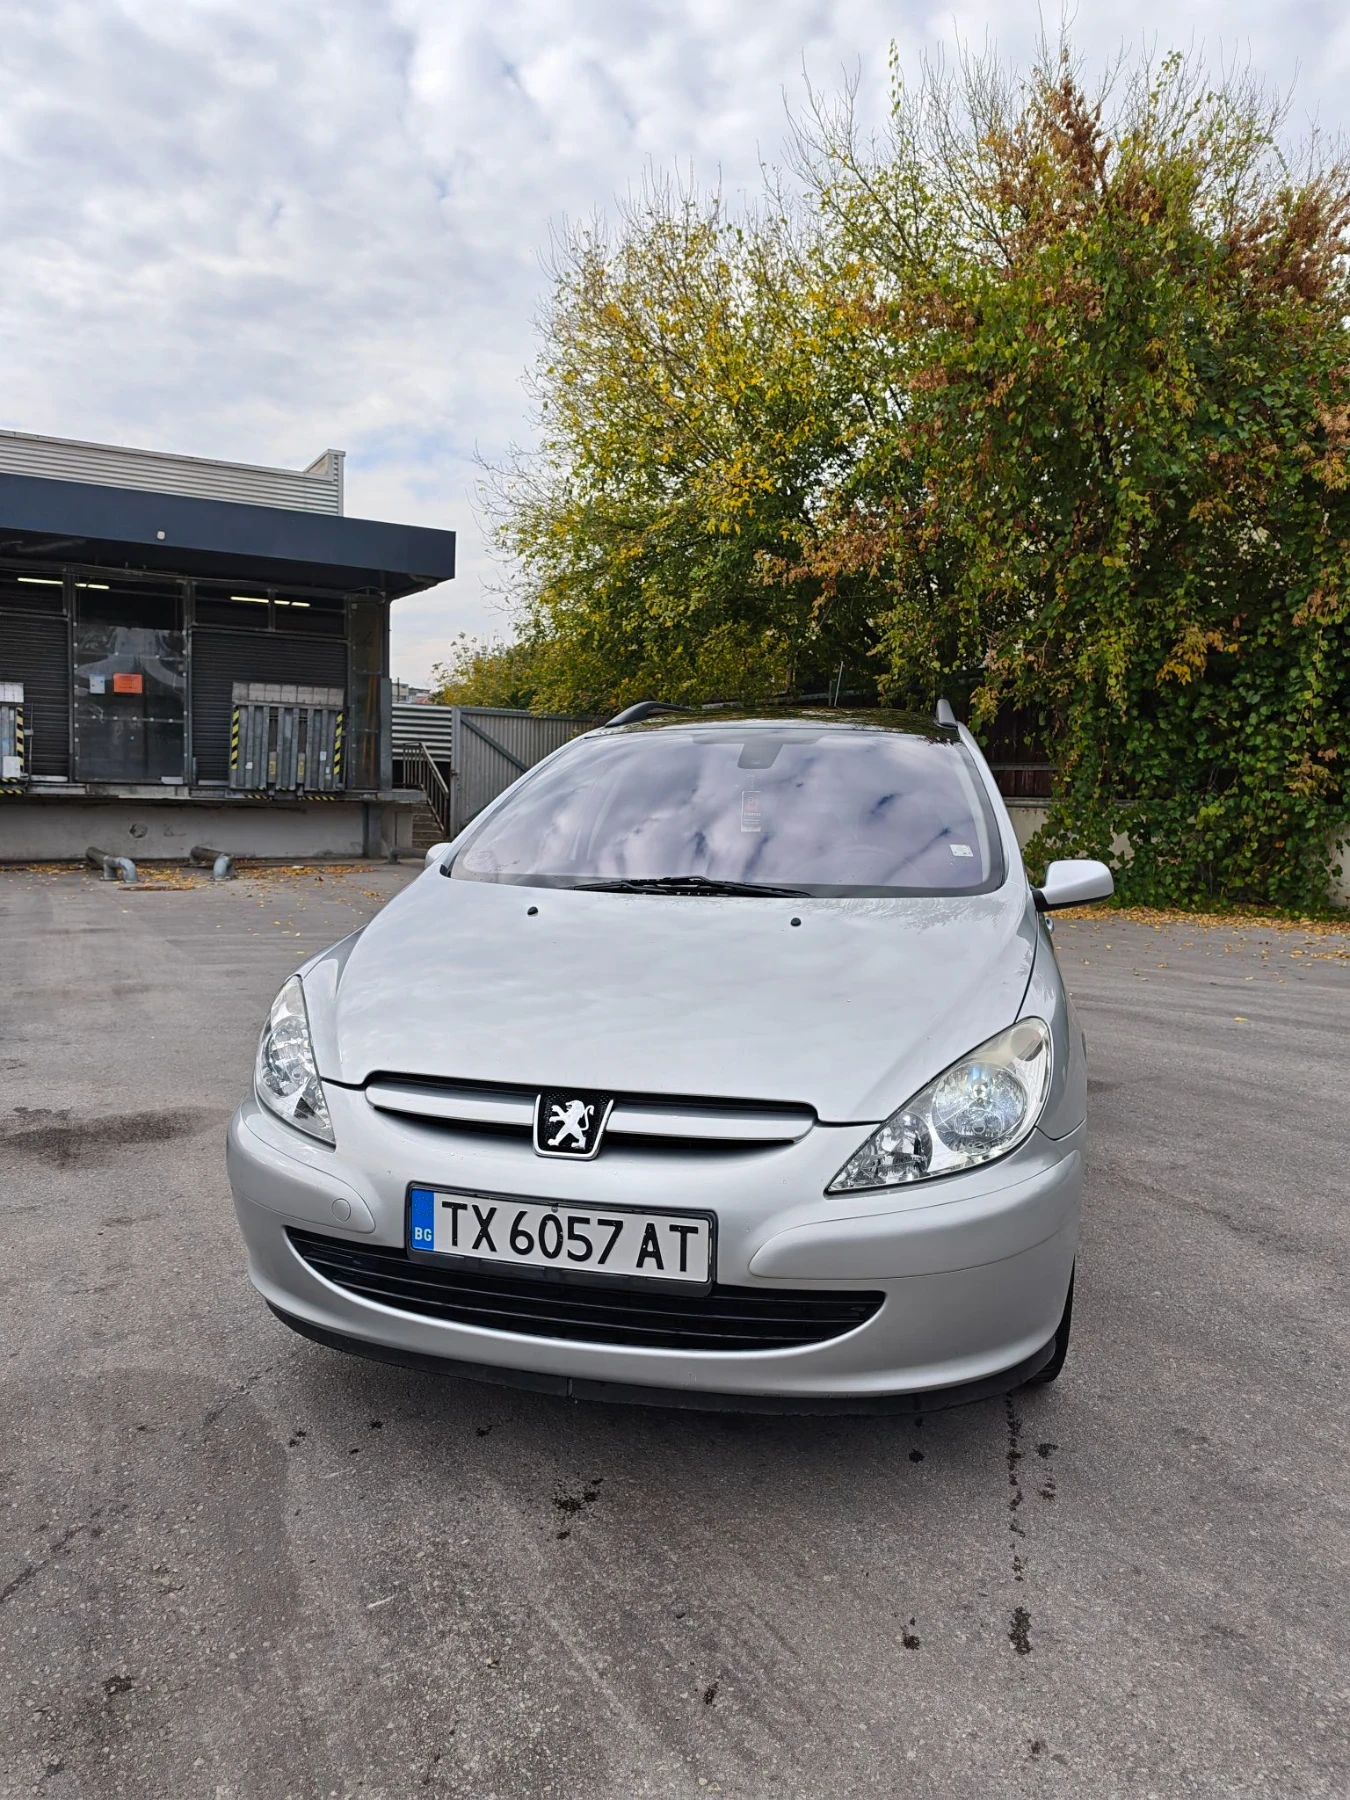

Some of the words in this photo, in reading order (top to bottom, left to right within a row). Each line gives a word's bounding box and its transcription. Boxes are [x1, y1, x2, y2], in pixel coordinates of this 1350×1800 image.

[414, 1226, 432, 1242] BG
[441, 1200, 498, 1253] TX
[509, 1210, 624, 1265] 6057
[635, 1222, 699, 1272] AT
